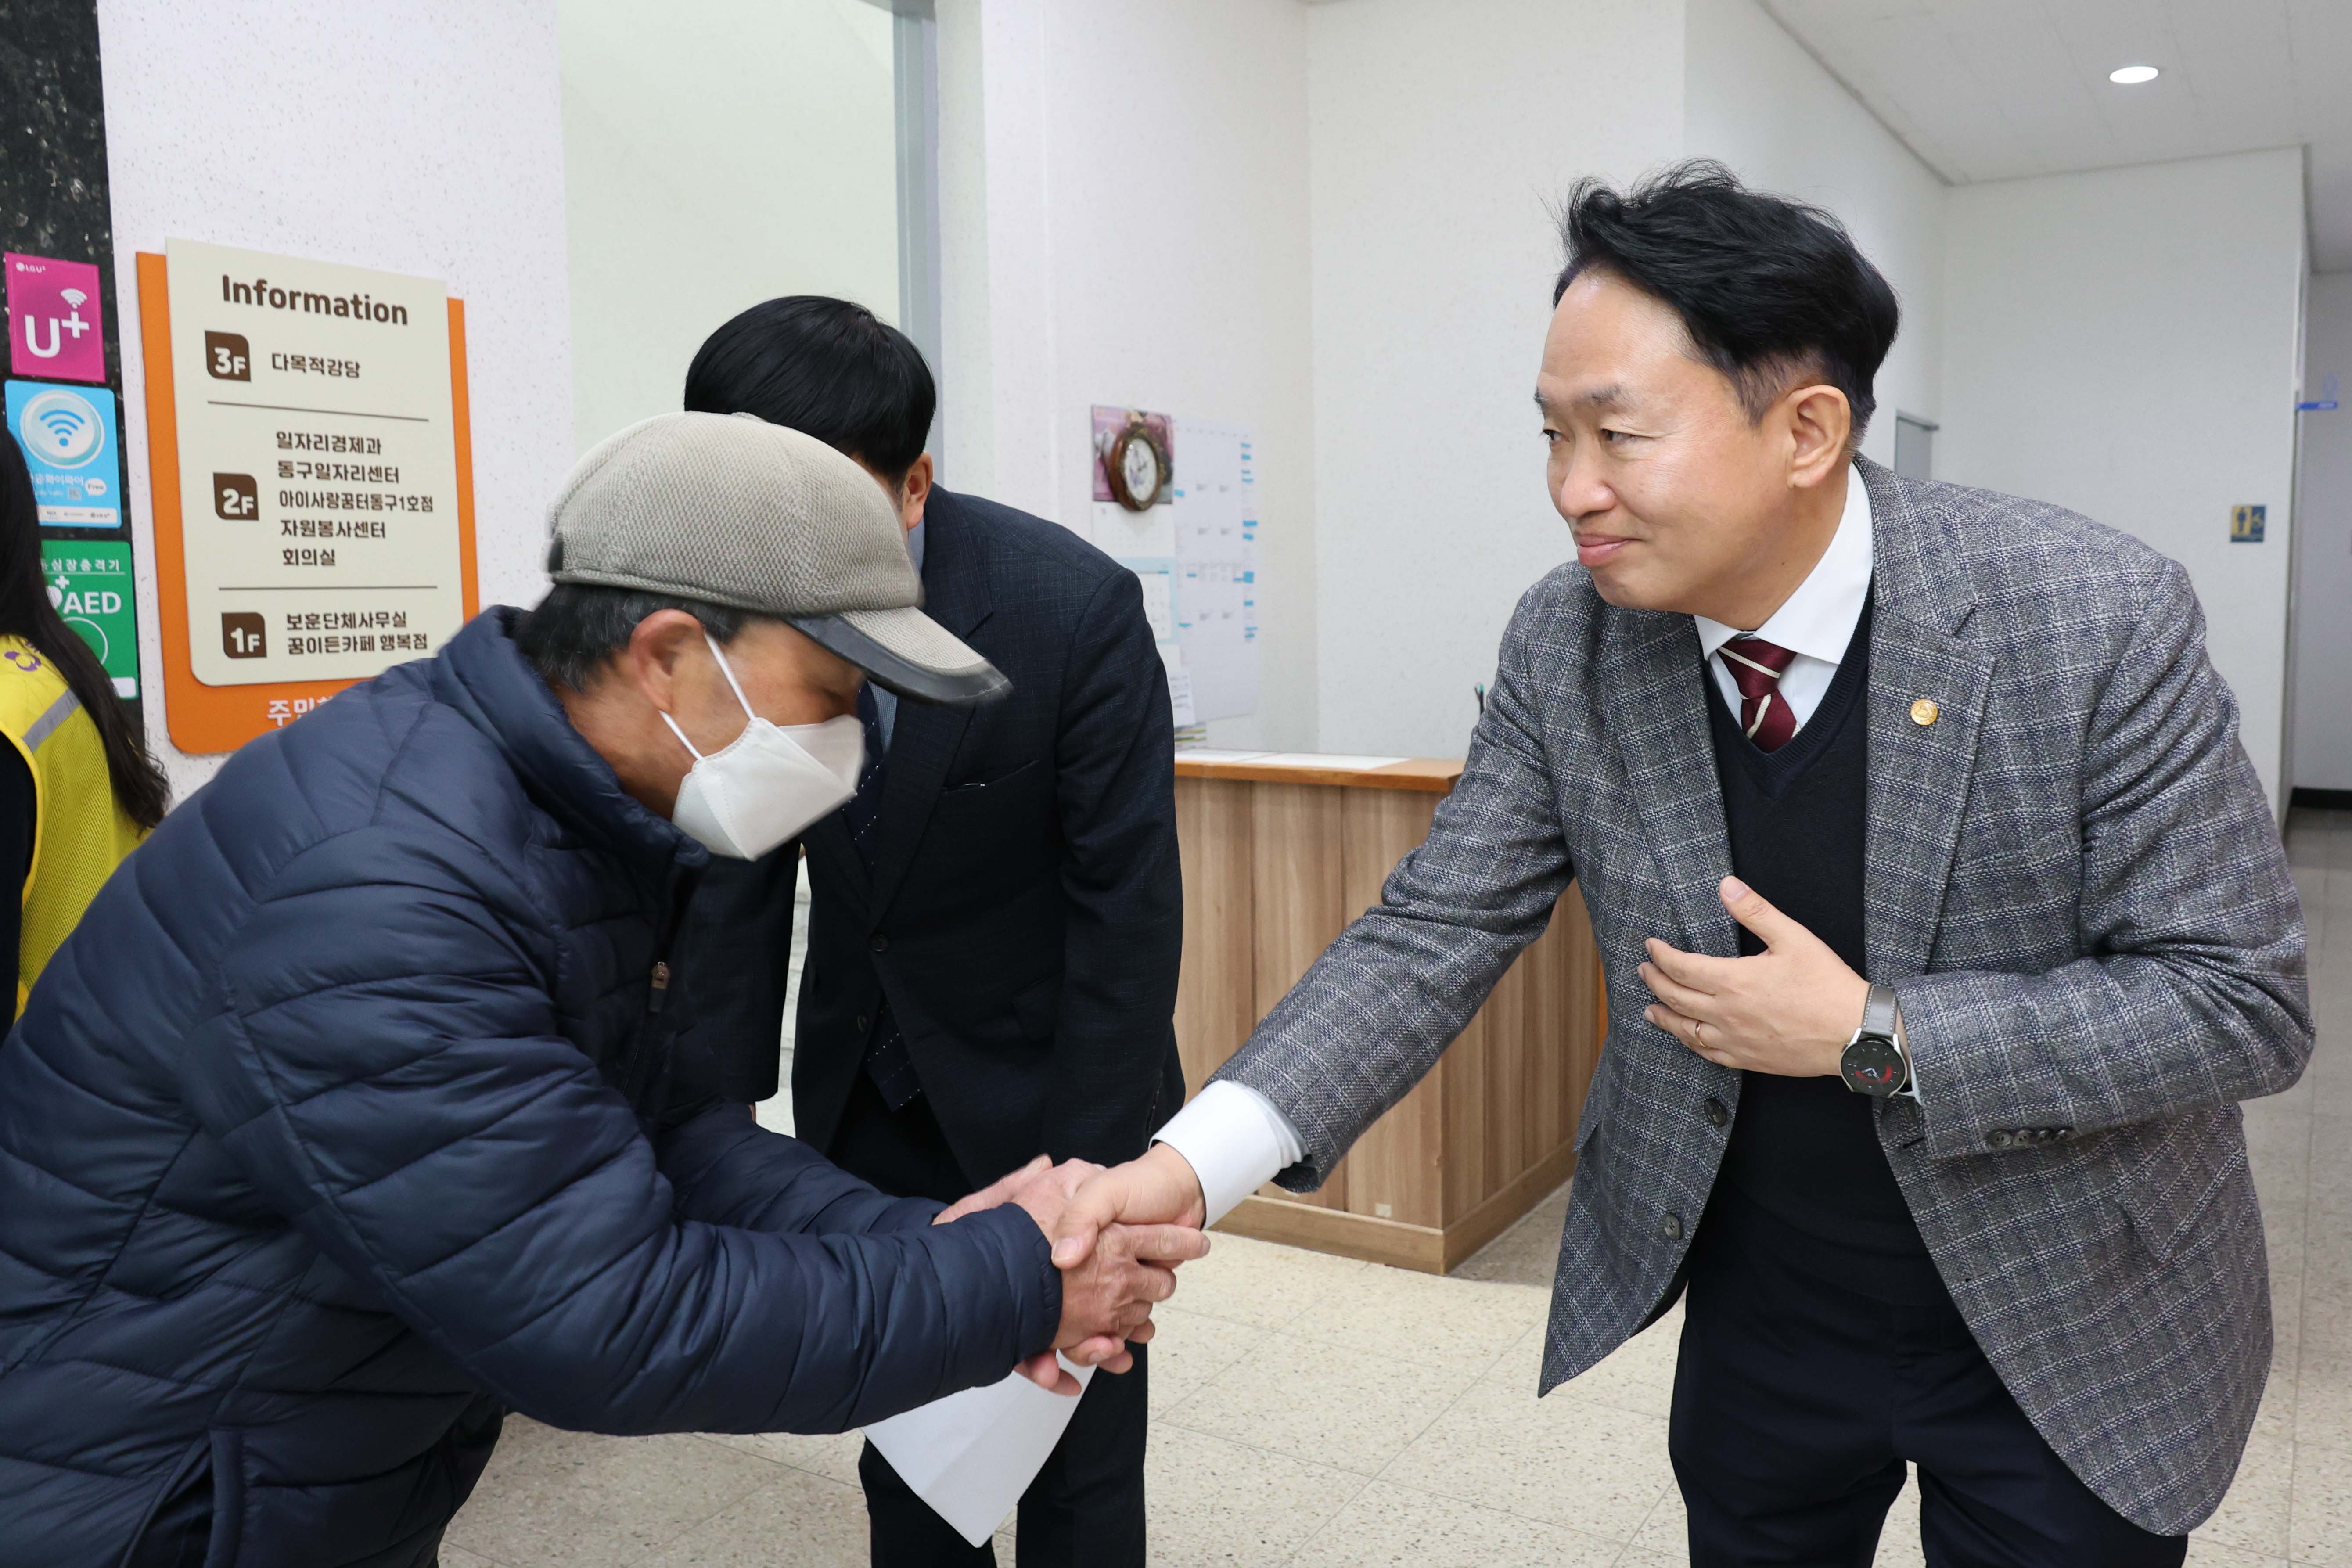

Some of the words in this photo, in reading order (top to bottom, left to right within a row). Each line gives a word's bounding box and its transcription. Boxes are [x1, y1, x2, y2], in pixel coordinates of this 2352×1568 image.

[222, 275, 408, 325] Information
[25, 311, 90, 358] U+
[214, 347, 246, 375] 3F
[272, 353, 360, 378] 다목적강당
[276, 431, 382, 455] 일자리경제과
[278, 460, 399, 484] 동구일자리센터
[222, 488, 254, 515] 2F
[279, 490, 433, 513] 아이사랑꿈터동구1호점
[281, 519, 386, 539] 자원봉사센터
[283, 548, 335, 566] 회의실
[62, 591, 122, 615] AED
[287, 611, 407, 631] 보훈단체사무실
[230, 627, 260, 653] 1F
[288, 636, 375, 655] 꿈이든카페
[380, 633, 428, 651] 행복점
[266, 696, 333, 726] 주민
